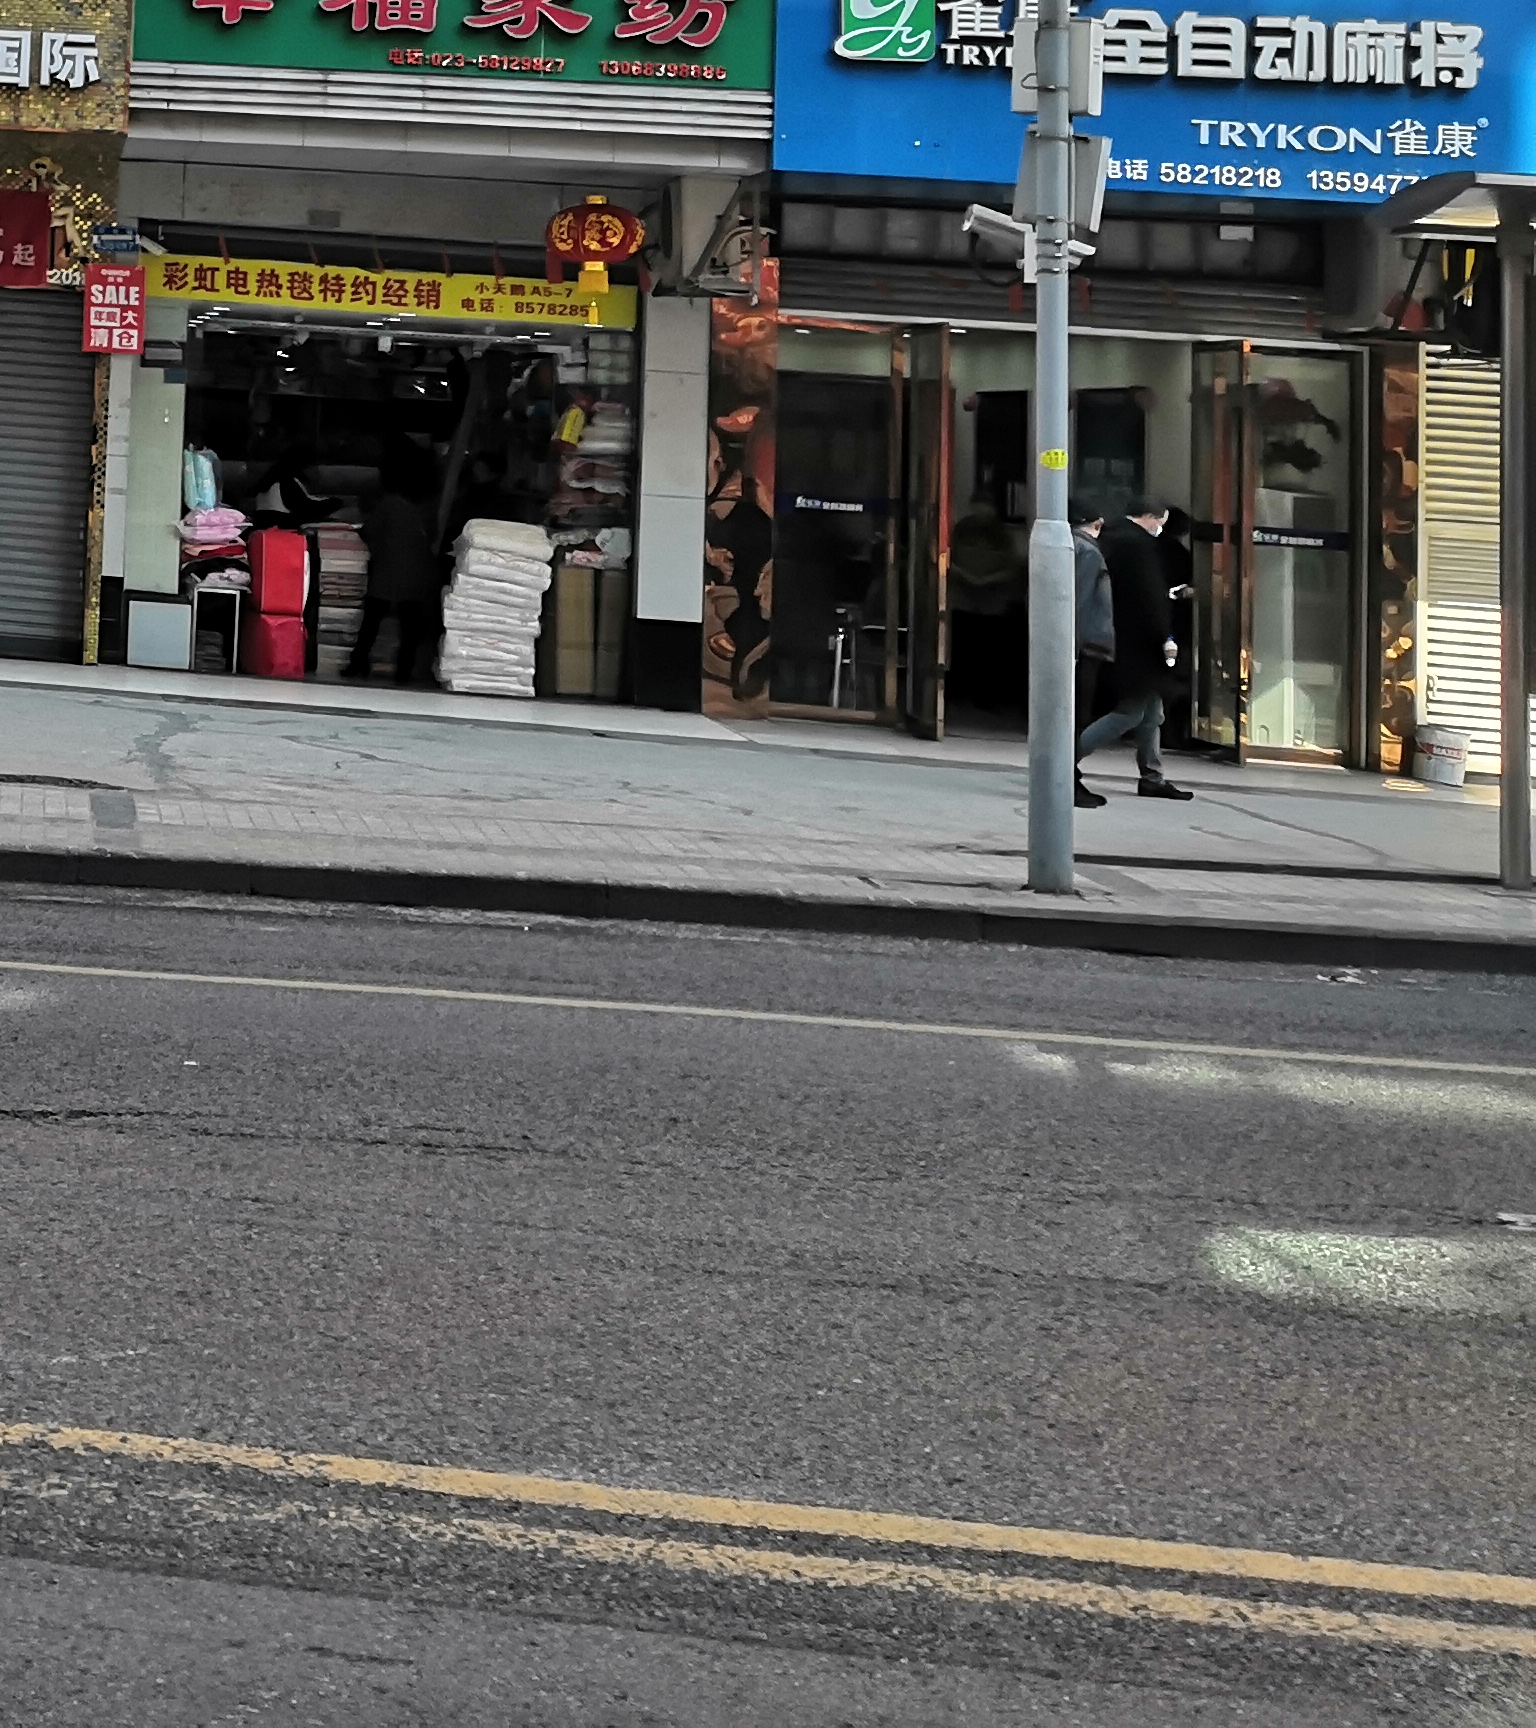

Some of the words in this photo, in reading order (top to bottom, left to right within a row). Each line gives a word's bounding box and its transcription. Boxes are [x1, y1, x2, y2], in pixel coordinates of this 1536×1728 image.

[1160, 162, 1282, 188] 58218218
[89, 284, 140, 306] SALE
[162, 261, 442, 310] 彩虹电热毯特约经销
